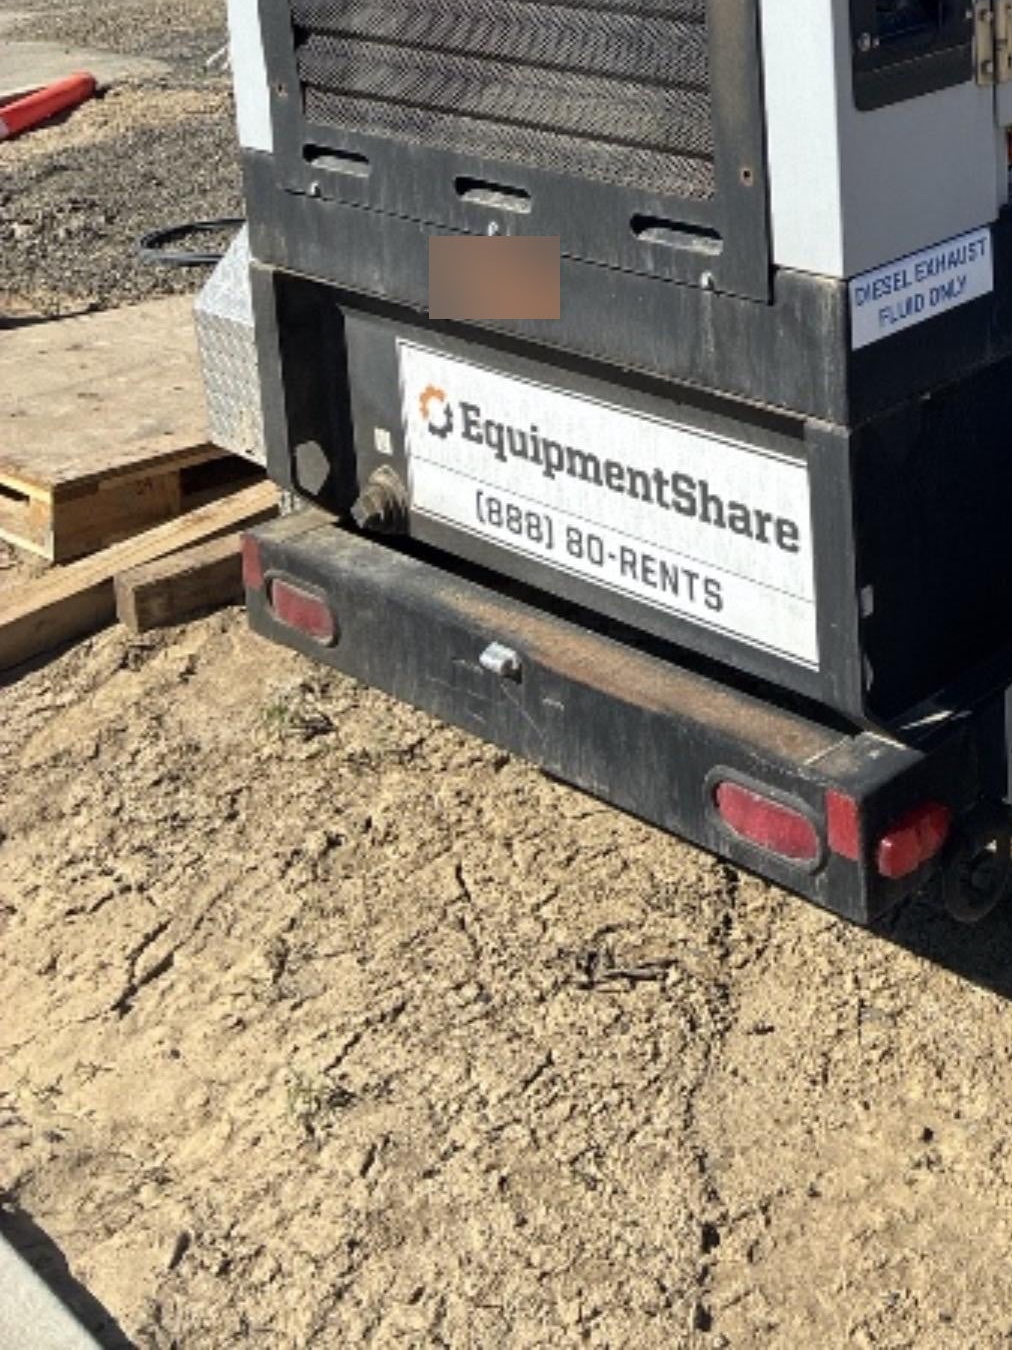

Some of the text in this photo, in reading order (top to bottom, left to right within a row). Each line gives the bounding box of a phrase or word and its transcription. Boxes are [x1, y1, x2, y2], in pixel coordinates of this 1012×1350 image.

[855, 236, 988, 307] DIESEL EXHAUST
[879, 274, 967, 327] FLUID ONLY
[459, 401, 801, 554] EquipmentShare
[475, 489, 725, 613] (888) 80-RENTS
